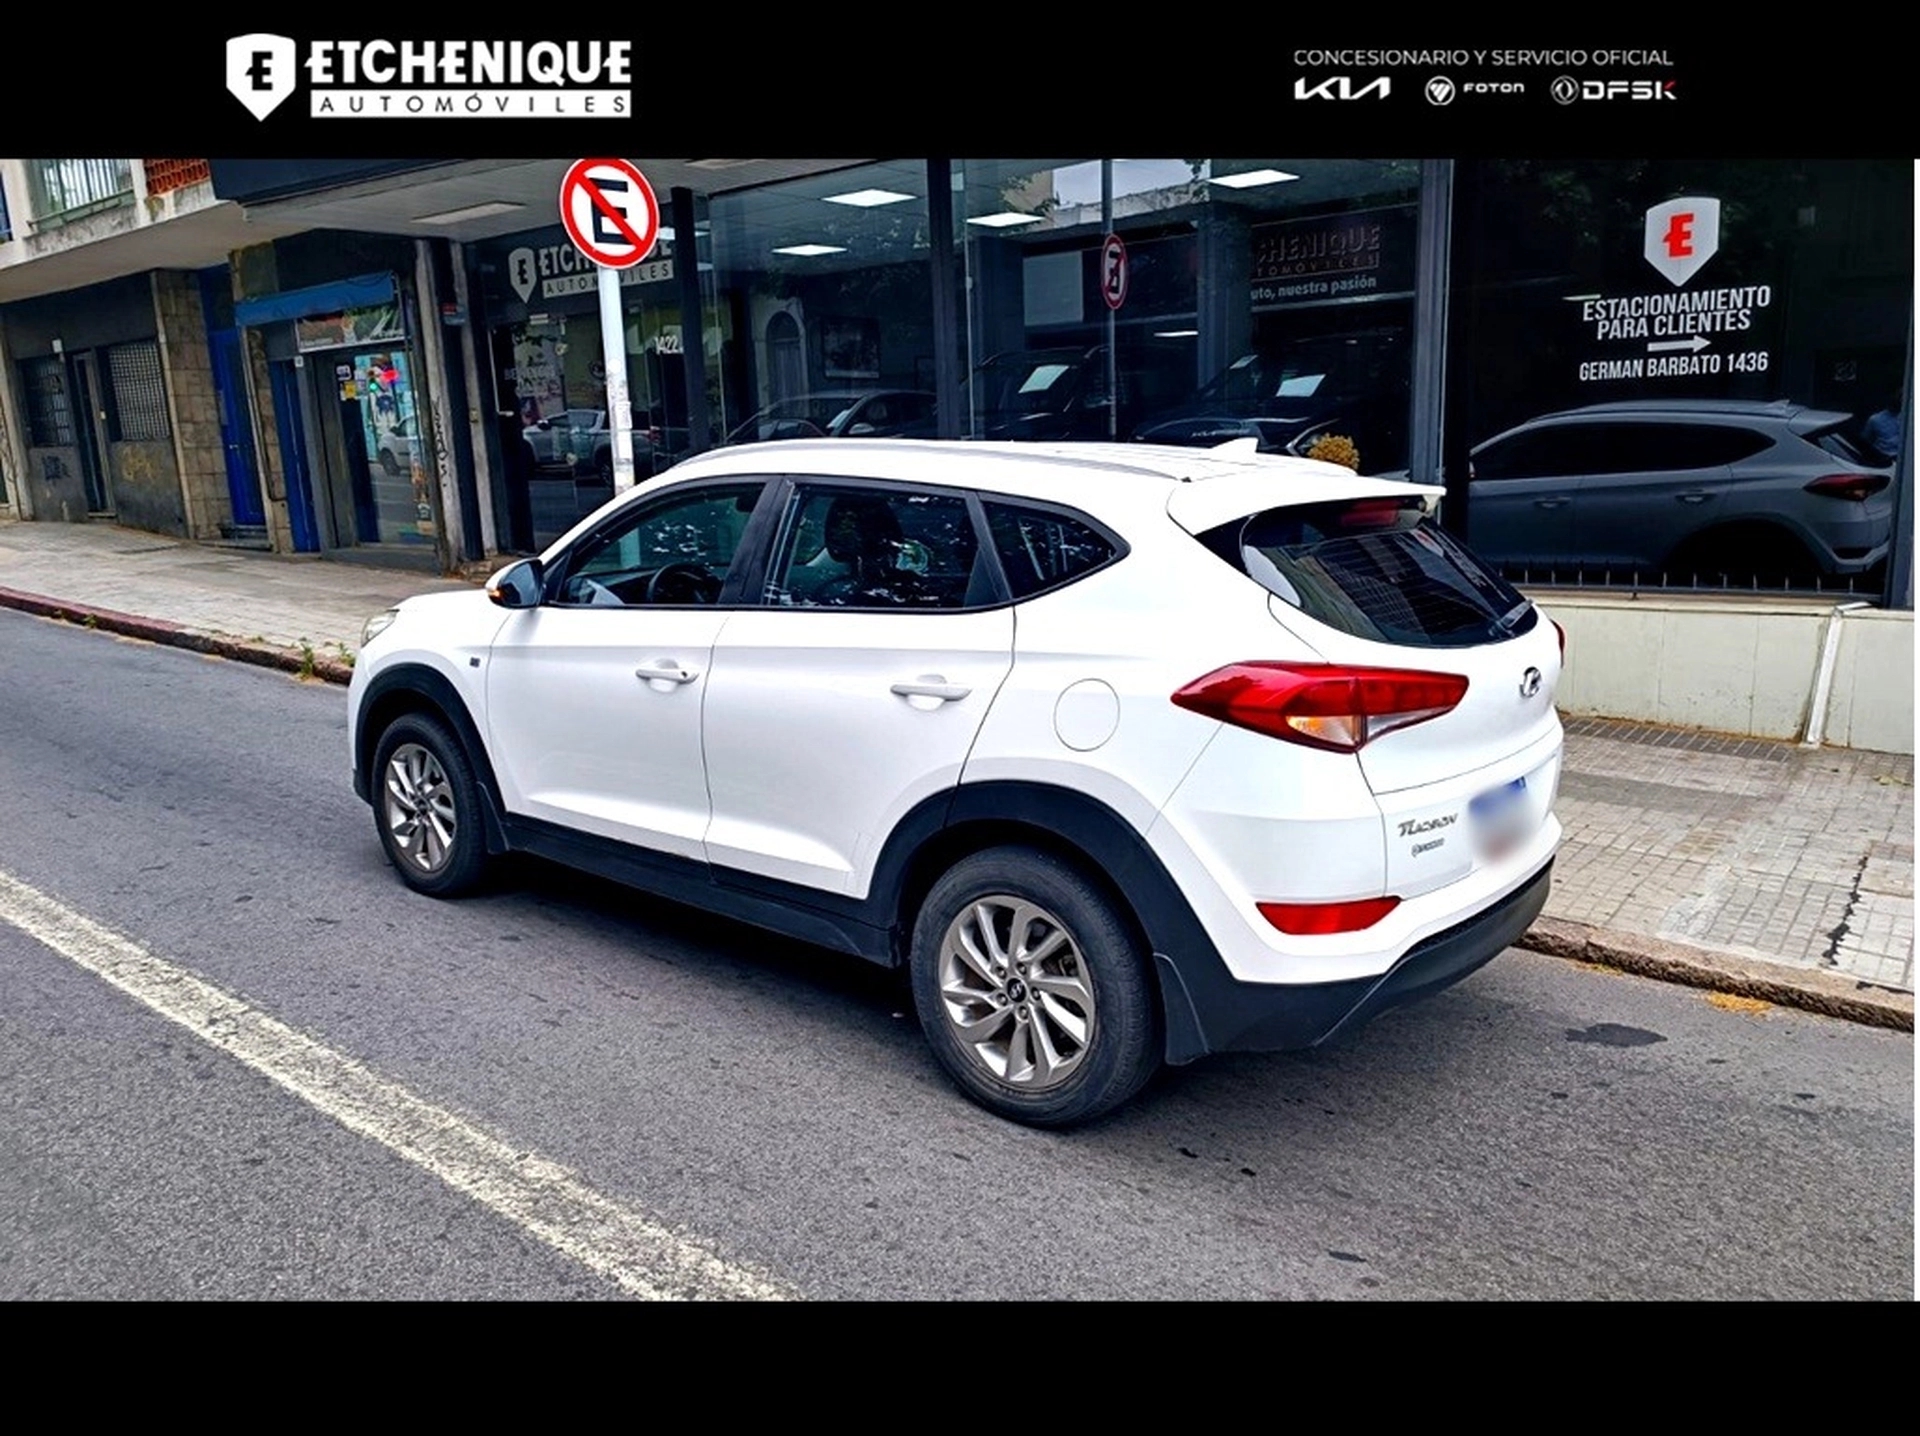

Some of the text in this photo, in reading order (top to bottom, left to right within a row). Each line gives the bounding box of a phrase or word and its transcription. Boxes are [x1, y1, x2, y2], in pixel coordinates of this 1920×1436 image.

[1278, 281, 1329, 297] nuestra
[1331, 274, 1377, 295] pasión
[1583, 285, 1772, 321] ESTACIONAMIENTO
[1597, 309, 1751, 340] PARA CLIENTES
[1579, 352, 1770, 381] GERMAN BARBATO 1436
